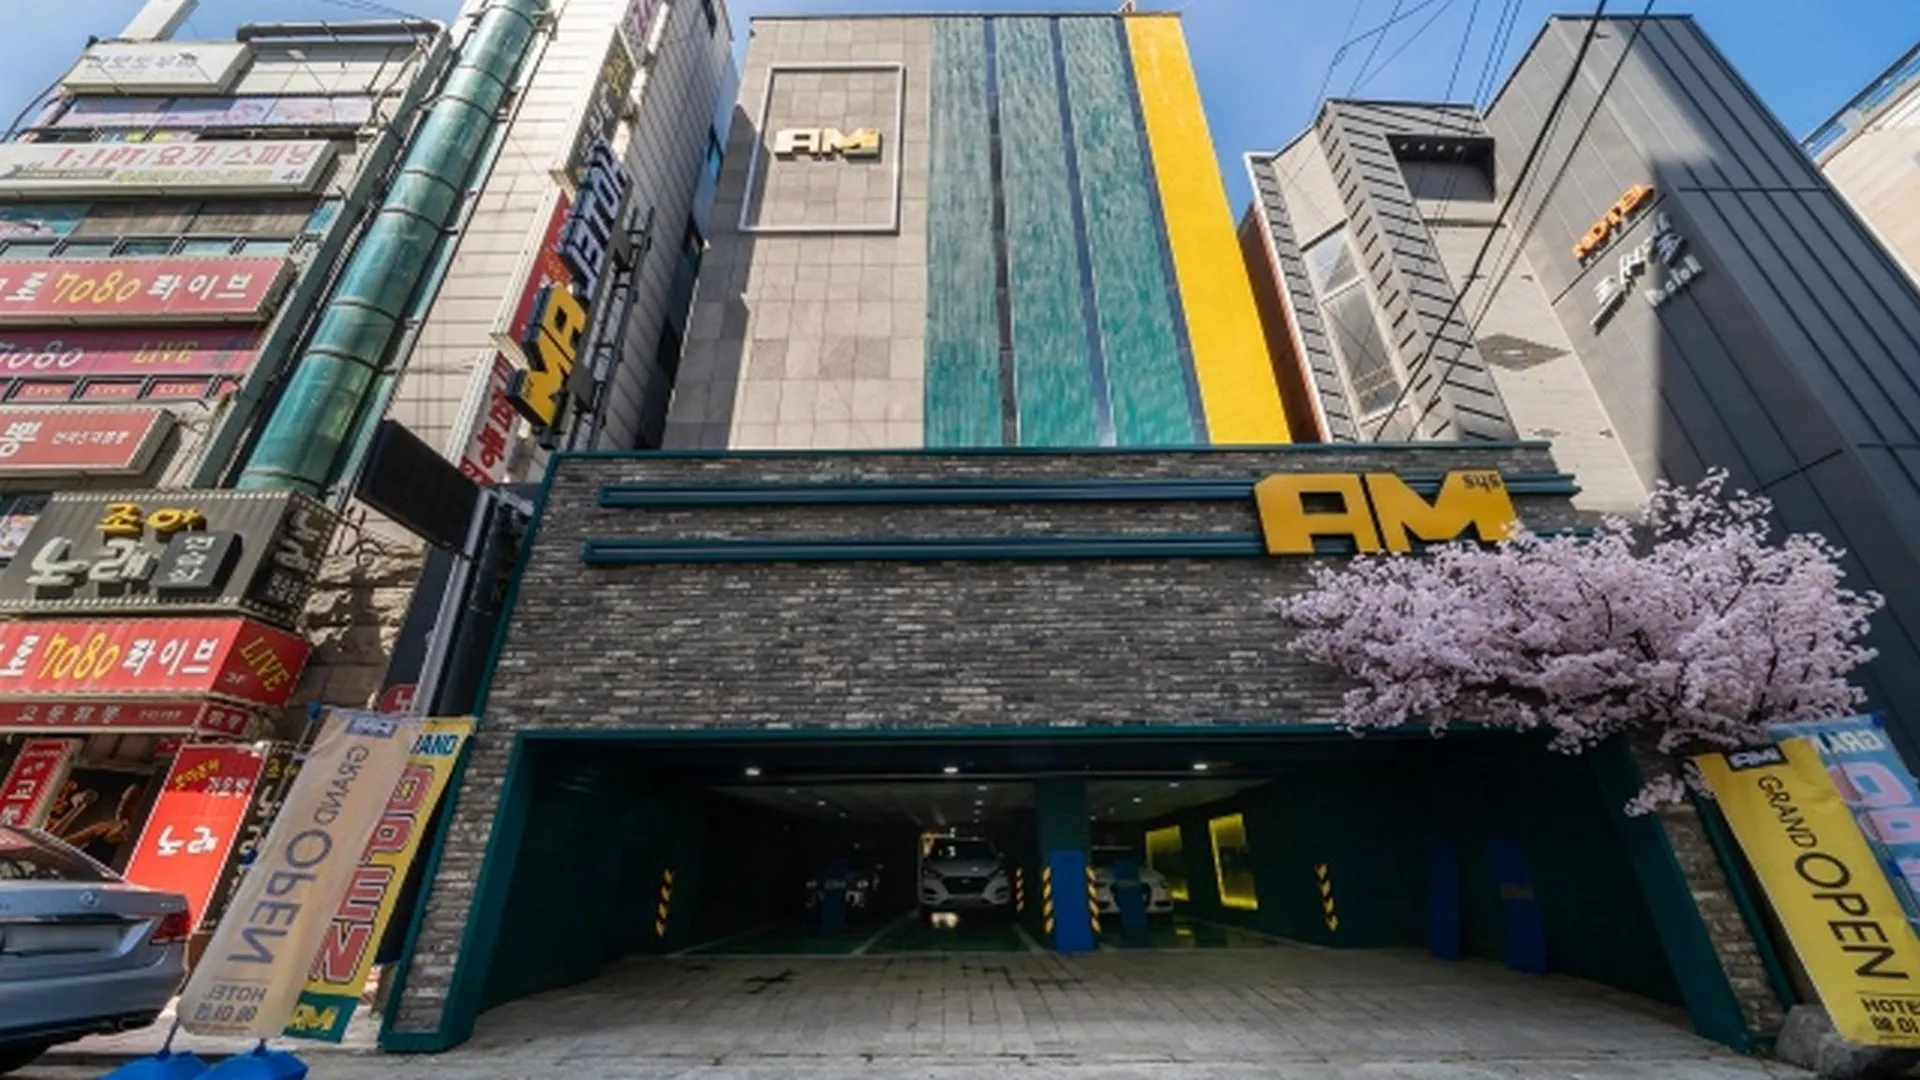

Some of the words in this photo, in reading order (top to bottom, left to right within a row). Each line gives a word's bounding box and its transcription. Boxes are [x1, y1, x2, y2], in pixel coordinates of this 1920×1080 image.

[774, 128, 880, 154] AM
[53, 269, 141, 303] 7080
[131, 340, 198, 364] LIVE
[1254, 469, 1520, 555] AM
[38, 632, 121, 680] 7080
[240, 636, 290, 692] LIVE
[411, 732, 460, 756] AND
[1758, 774, 1818, 848] GRAND
[1794, 851, 1910, 982] OPEN
